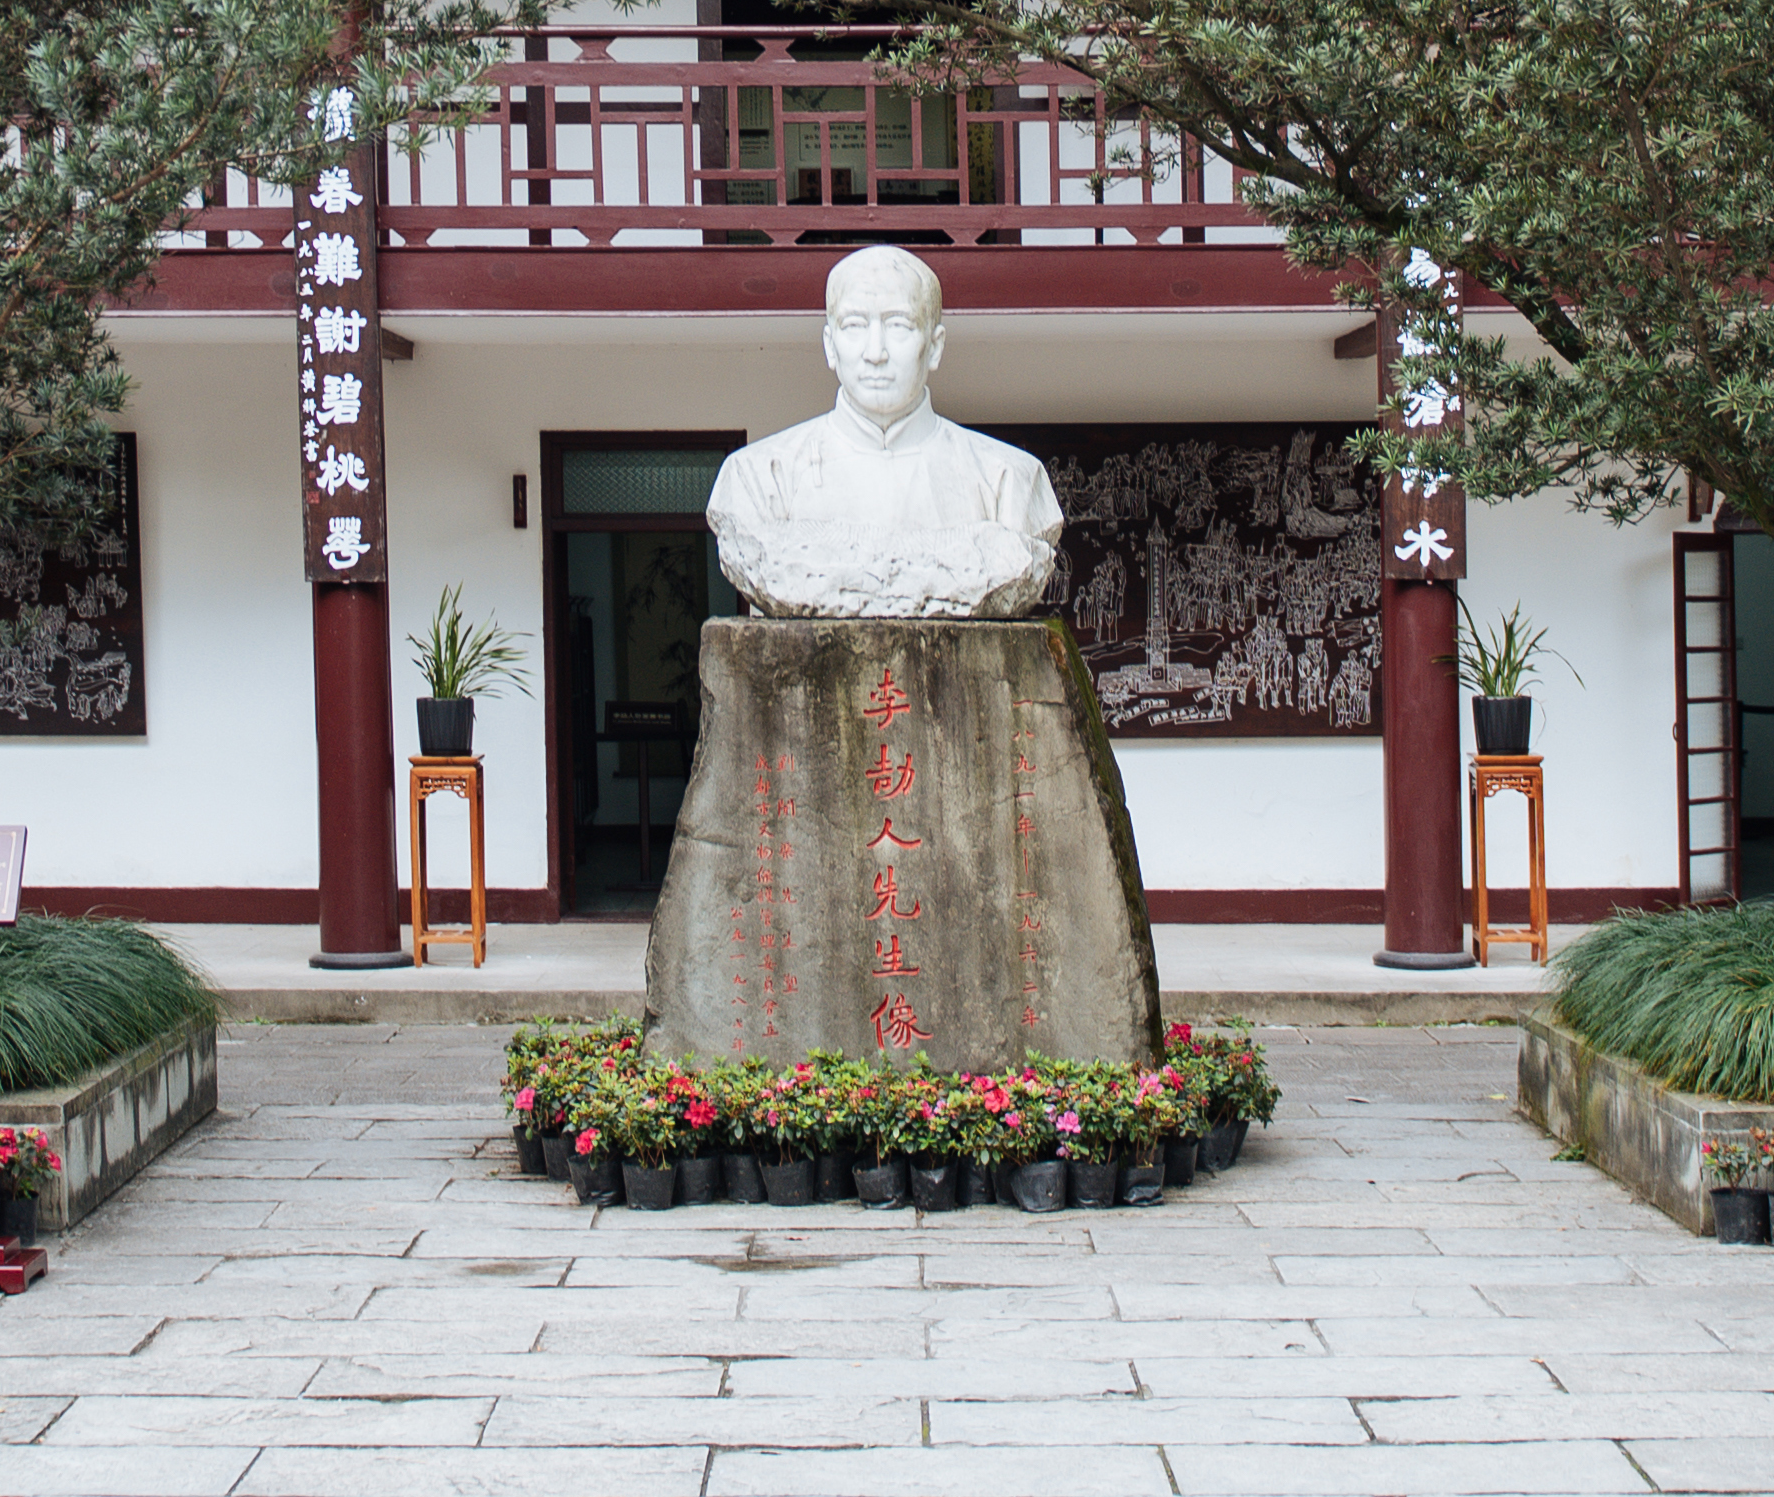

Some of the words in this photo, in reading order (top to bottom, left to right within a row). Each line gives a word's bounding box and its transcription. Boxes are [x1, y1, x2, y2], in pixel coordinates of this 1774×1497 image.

[863, 668, 934, 1051] 李劼人先生像
